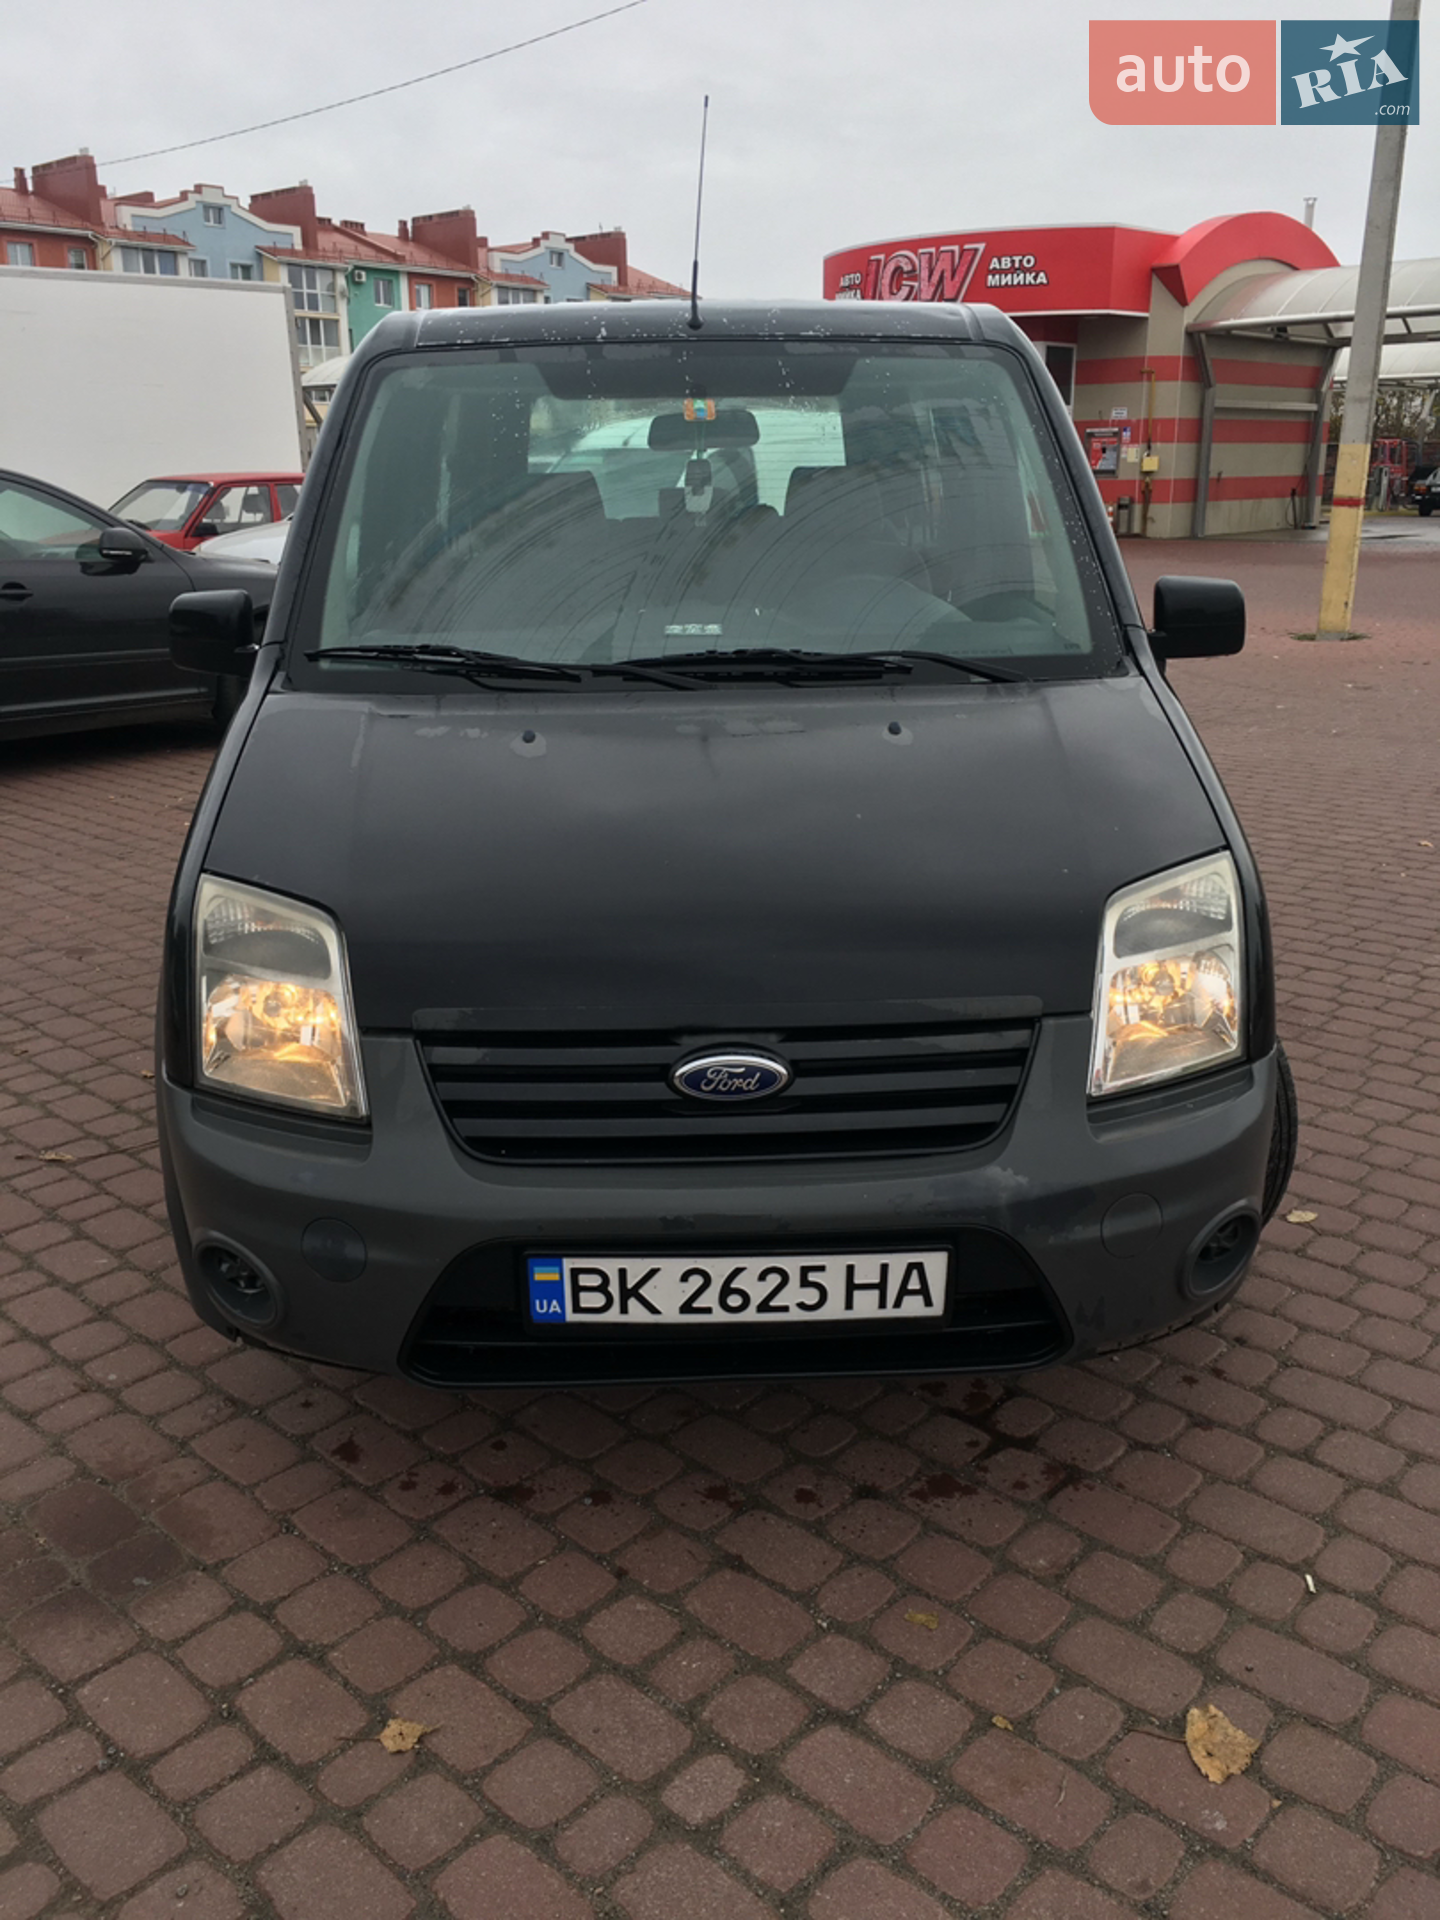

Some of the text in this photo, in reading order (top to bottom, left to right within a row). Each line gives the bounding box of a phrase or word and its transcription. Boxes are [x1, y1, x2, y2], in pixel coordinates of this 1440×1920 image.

[989, 255, 1035, 270] АВТО
[987, 270, 1048, 287] МИЙКА
[701, 1066, 761, 1091] Ford
[569, 1261, 934, 1315] BK 2625 HA
[534, 1299, 563, 1315] UA
